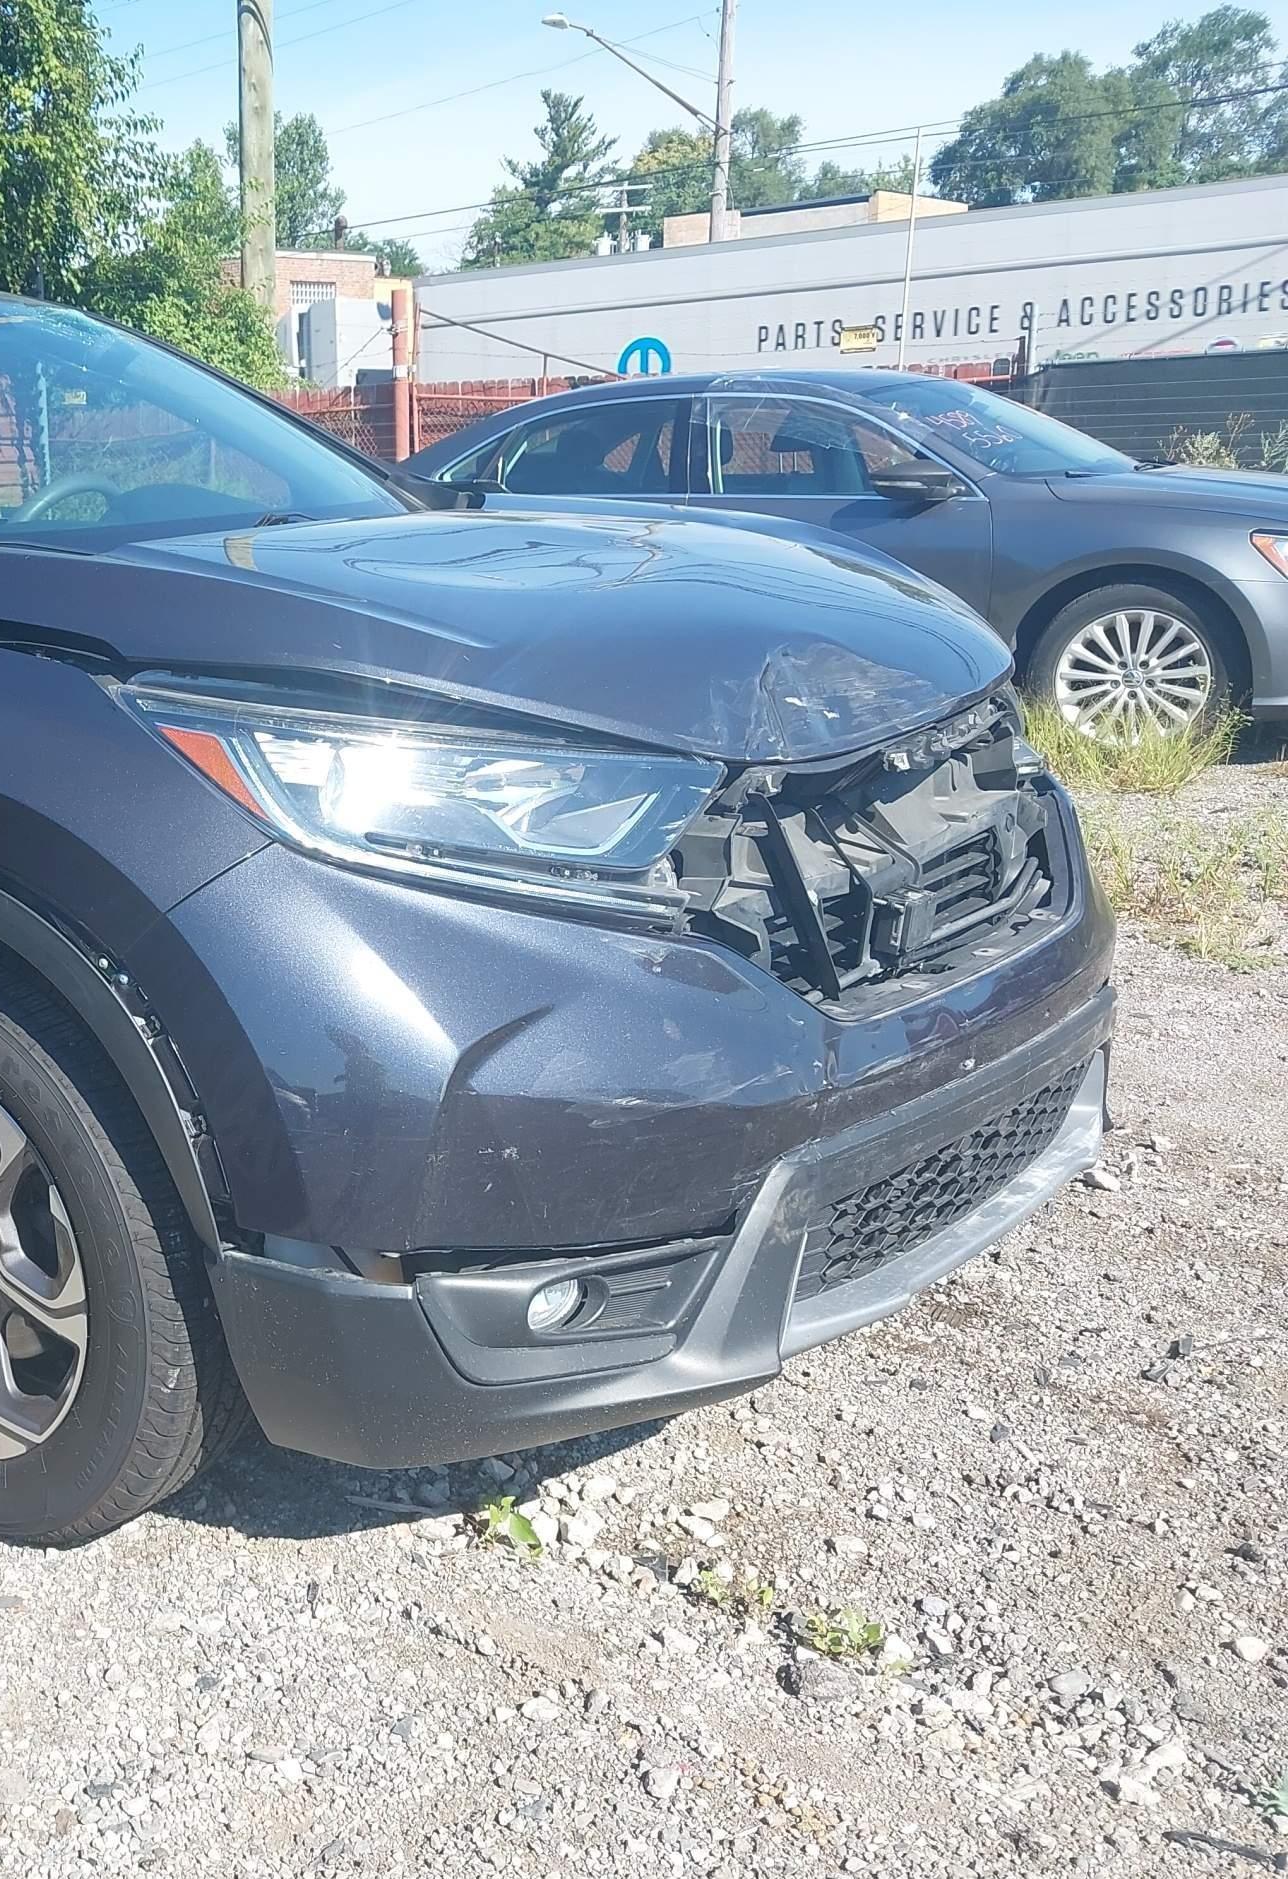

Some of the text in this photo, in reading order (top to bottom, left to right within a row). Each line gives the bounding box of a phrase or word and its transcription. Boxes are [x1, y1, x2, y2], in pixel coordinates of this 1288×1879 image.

[758, 279, 1288, 352] PARTS SERVICE & ACCESSORIES
